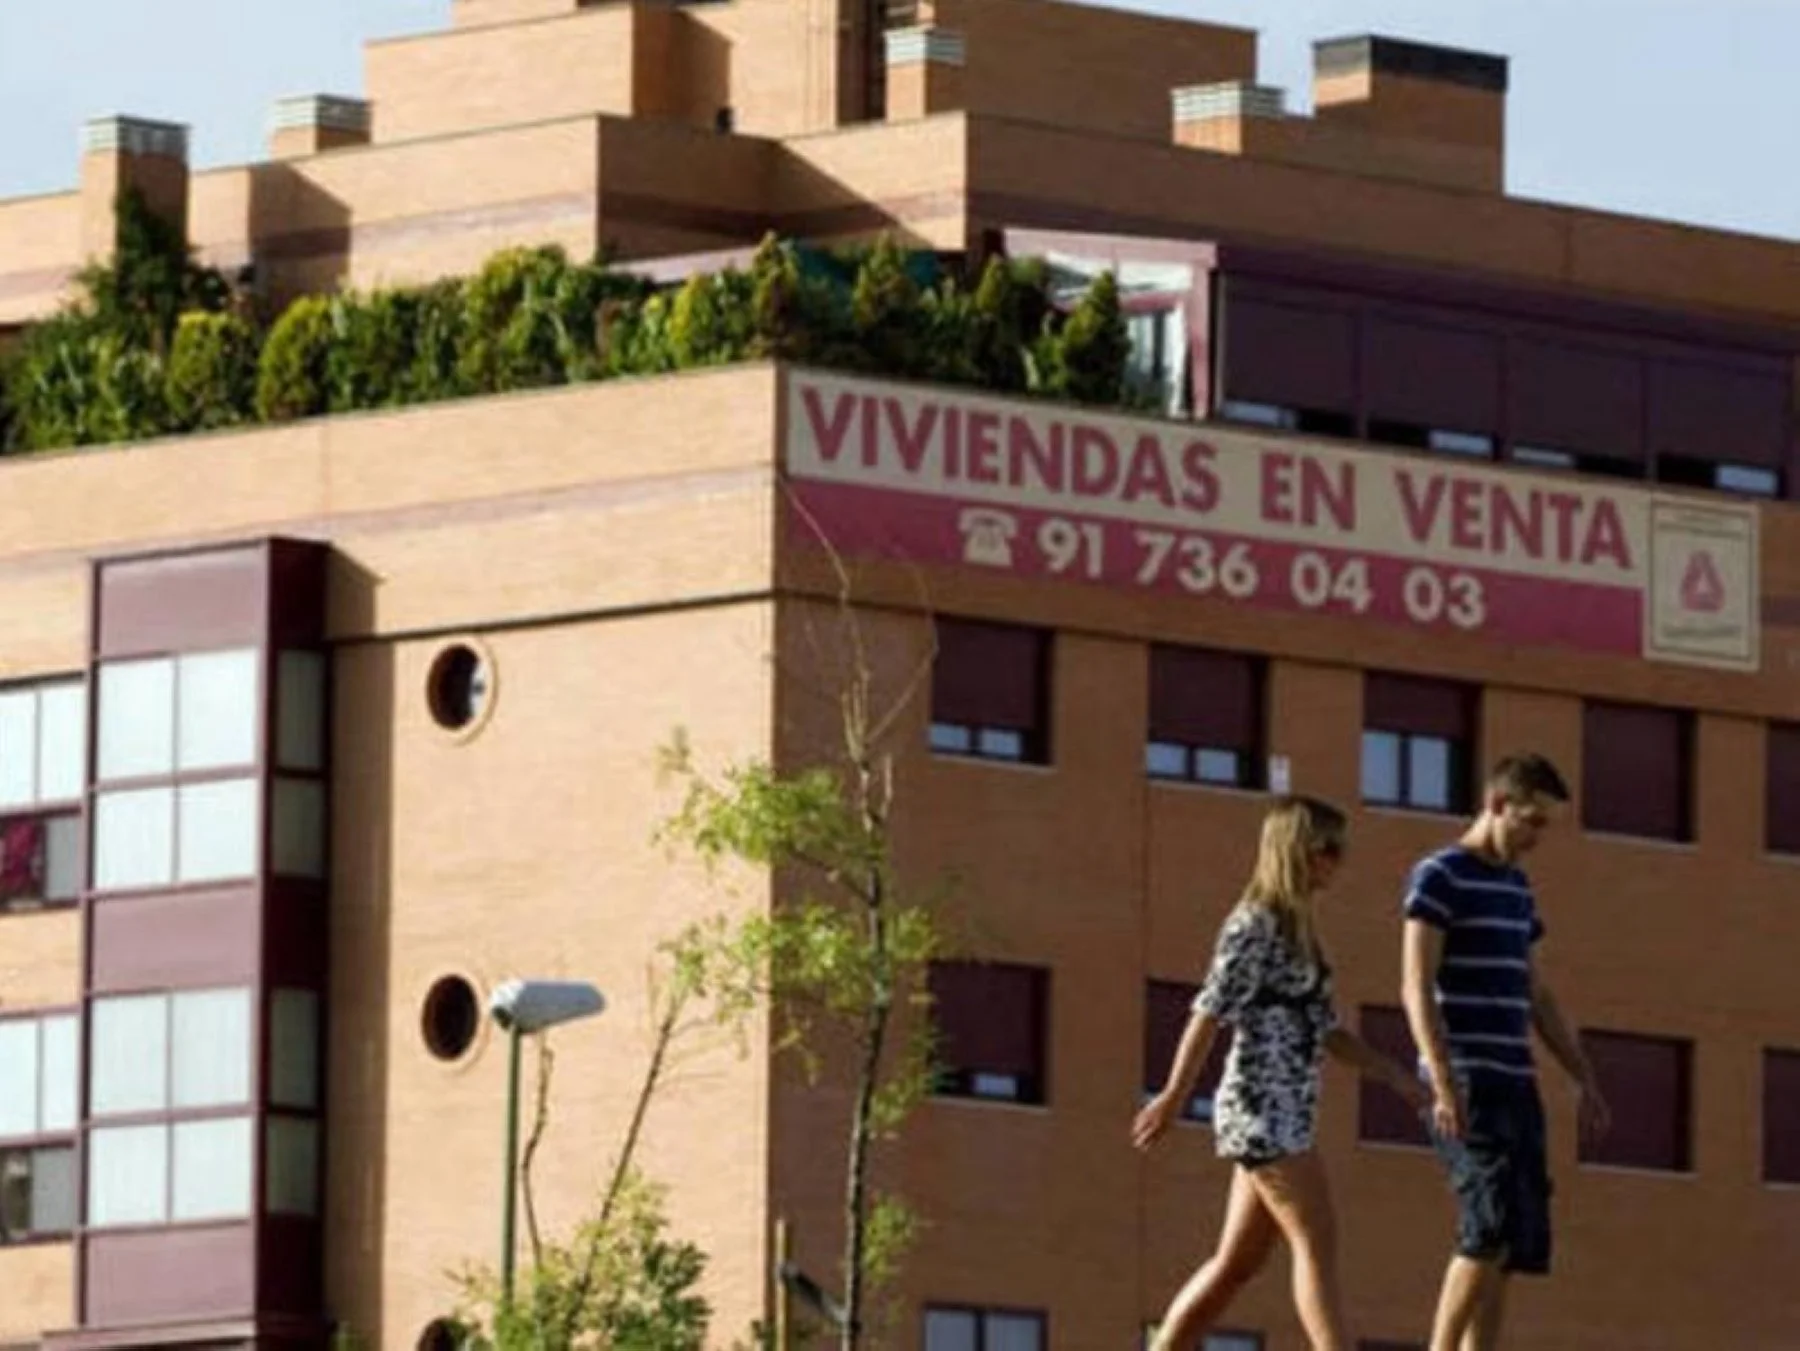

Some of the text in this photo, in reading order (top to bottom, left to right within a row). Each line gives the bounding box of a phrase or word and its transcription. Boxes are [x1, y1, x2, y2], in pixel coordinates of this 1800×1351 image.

[801, 385, 1633, 570] VIVIENDAS EN VENTA
[1037, 517, 1485, 629] 91 736 04 03
